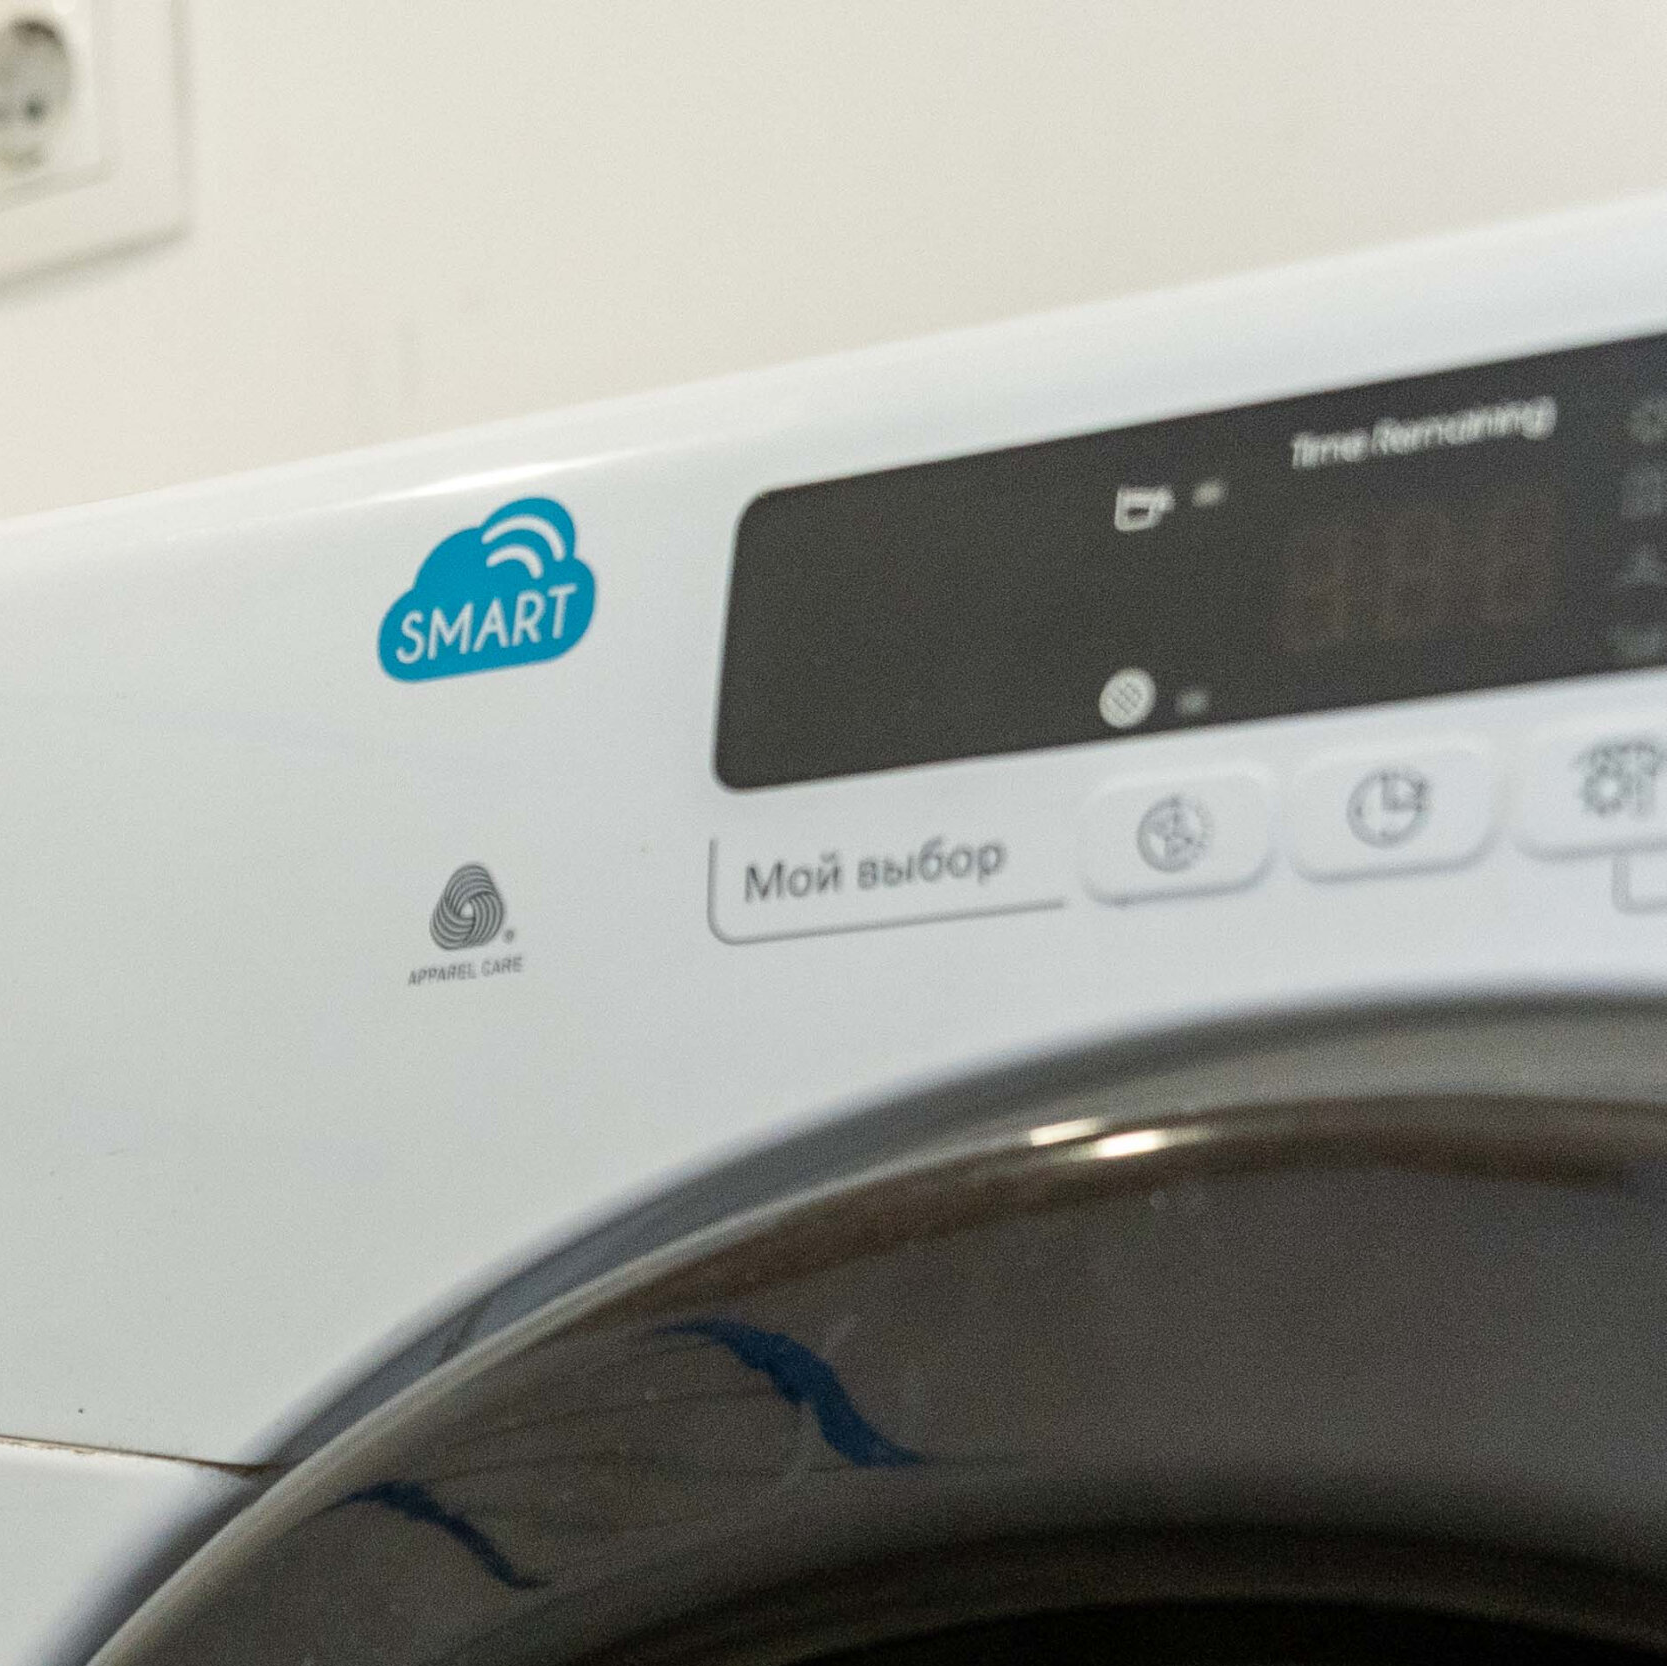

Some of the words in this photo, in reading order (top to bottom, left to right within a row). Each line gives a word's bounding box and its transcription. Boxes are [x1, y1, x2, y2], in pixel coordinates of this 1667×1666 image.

[396, 584, 578, 665] SMART
[745, 852, 841, 903] Мой
[858, 837, 1007, 890] выбор
[408, 962, 477, 986] APPAREL
[480, 956, 524, 978] CARE
